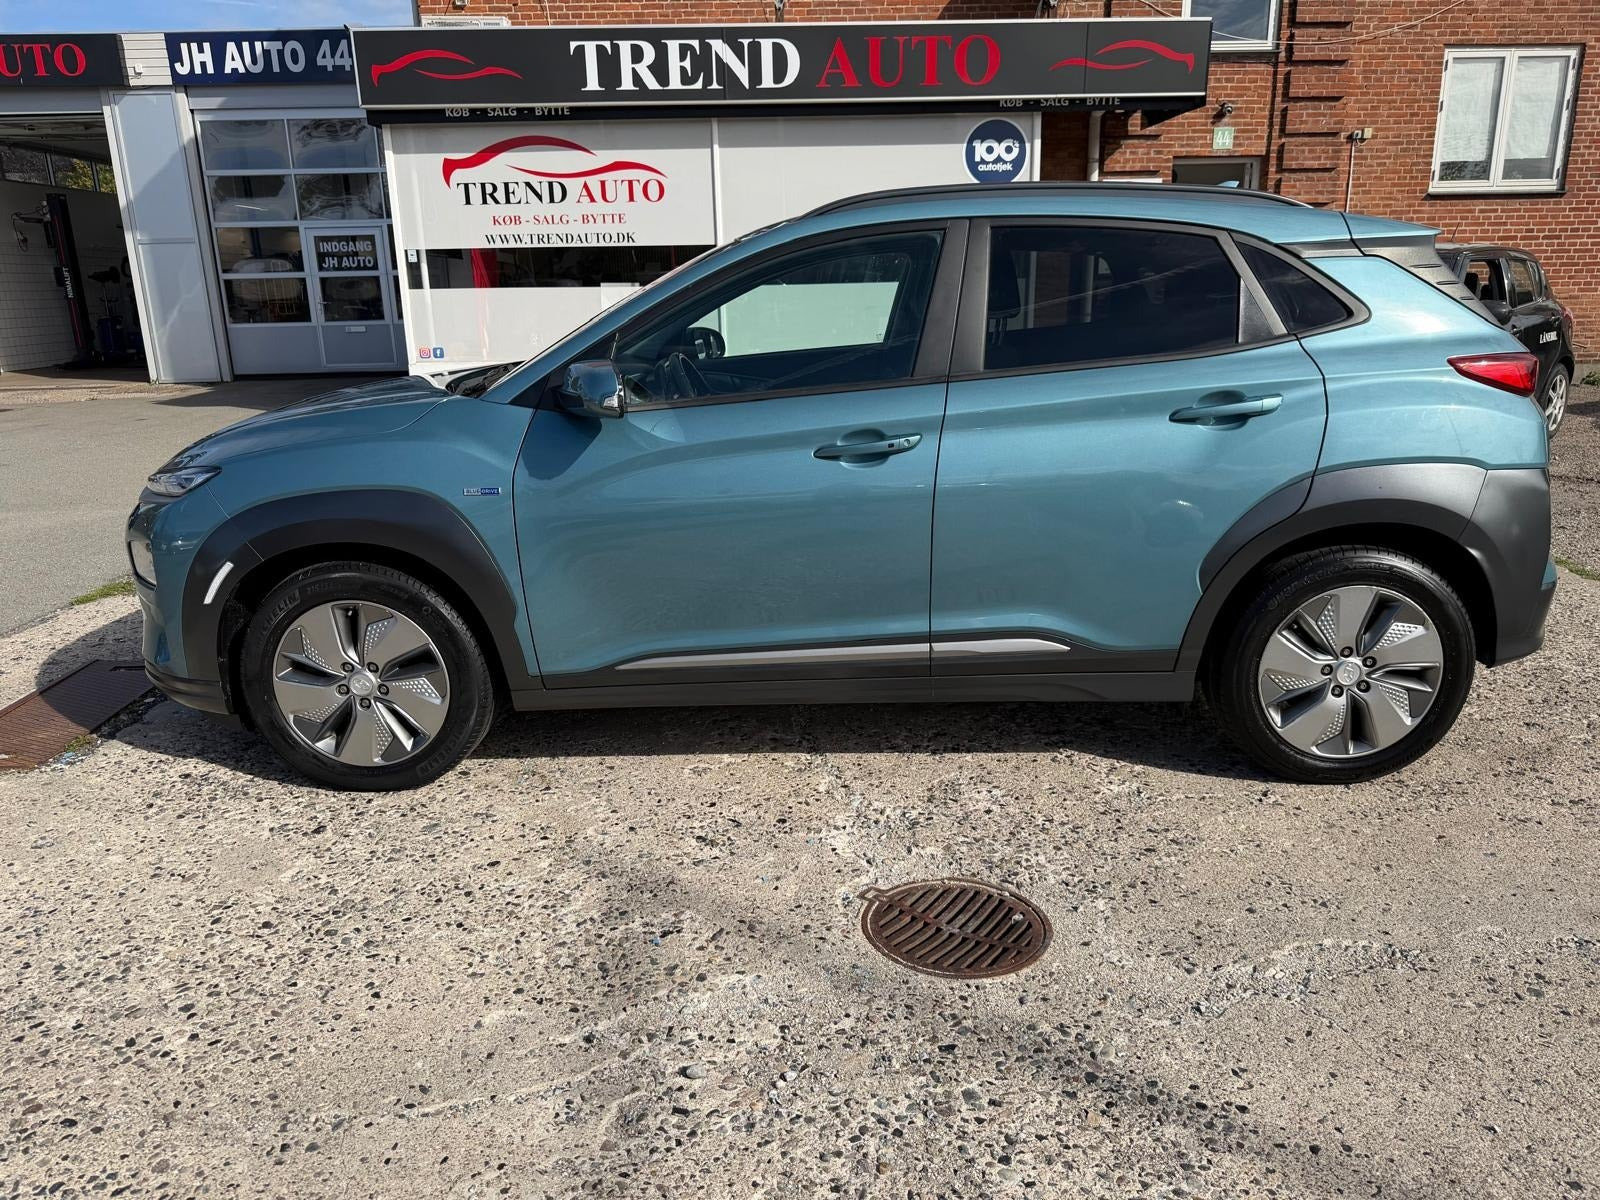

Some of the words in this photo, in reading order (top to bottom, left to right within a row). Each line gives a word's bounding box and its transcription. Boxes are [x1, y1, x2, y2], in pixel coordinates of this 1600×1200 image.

[174, 42, 214, 75] JH
[224, 40, 306, 74] AUTO
[316, 39, 352, 72] 44
[569, 38, 801, 92] TREND
[816, 34, 1000, 88] AUTO
[1000, 98, 1024, 108] KØB
[1040, 97, 1069, 107] SALG
[1086, 96, 1121, 106] BYTTE
[445, 107, 470, 117] KØB
[487, 106, 517, 117] SALG
[535, 106, 571, 116] BYTTE
[1216, 131, 1230, 146] 44
[978, 161, 1013, 173] autotjek
[457, 181, 568, 206] TREND
[576, 178, 665, 204] AUTO
[492, 214, 522, 226] KØB
[533, 213, 570, 226] SALG
[582, 213, 627, 225] BYTTE
[485, 231, 637, 246] WWW.TRENDAUTO.DK
[320, 241, 372, 252] INDGANG
[322, 256, 338, 268] JH
[342, 256, 374, 268] AUTO
